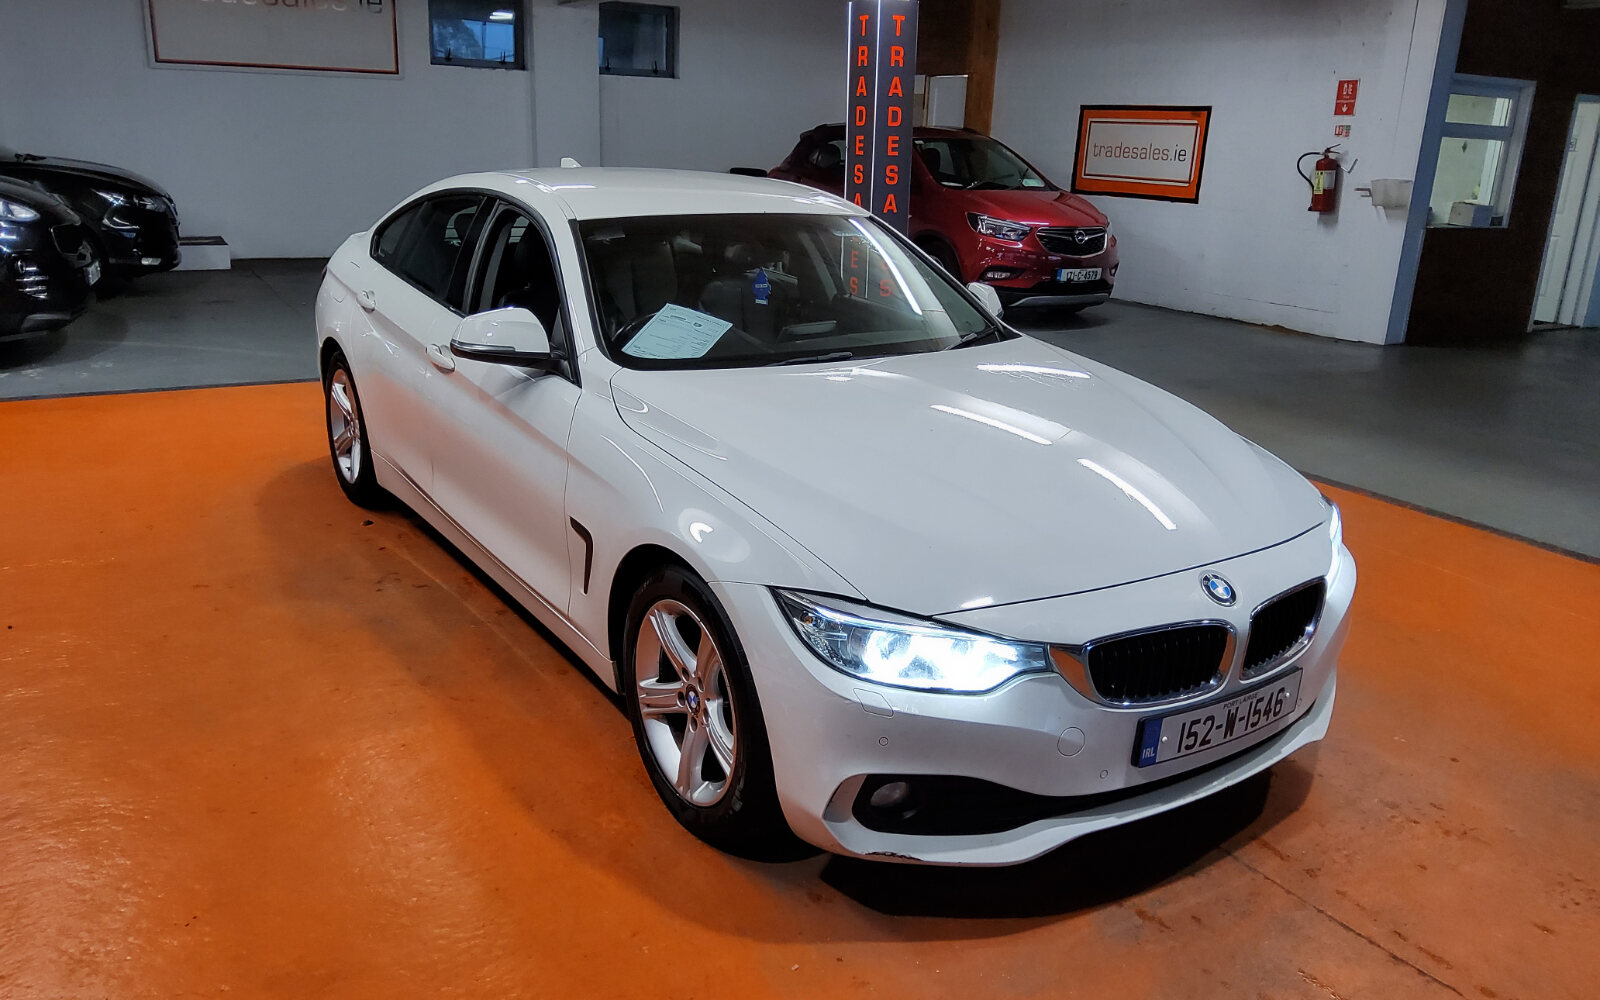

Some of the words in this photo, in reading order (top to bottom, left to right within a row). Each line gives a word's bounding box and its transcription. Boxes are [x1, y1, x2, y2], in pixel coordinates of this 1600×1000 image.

[1093, 142, 1187, 162] tradesales.ie
[1223, 699, 1239, 710] PORT
[1177, 687, 1286, 753] 152-W-1546
[1142, 747, 1155, 759] IRL
